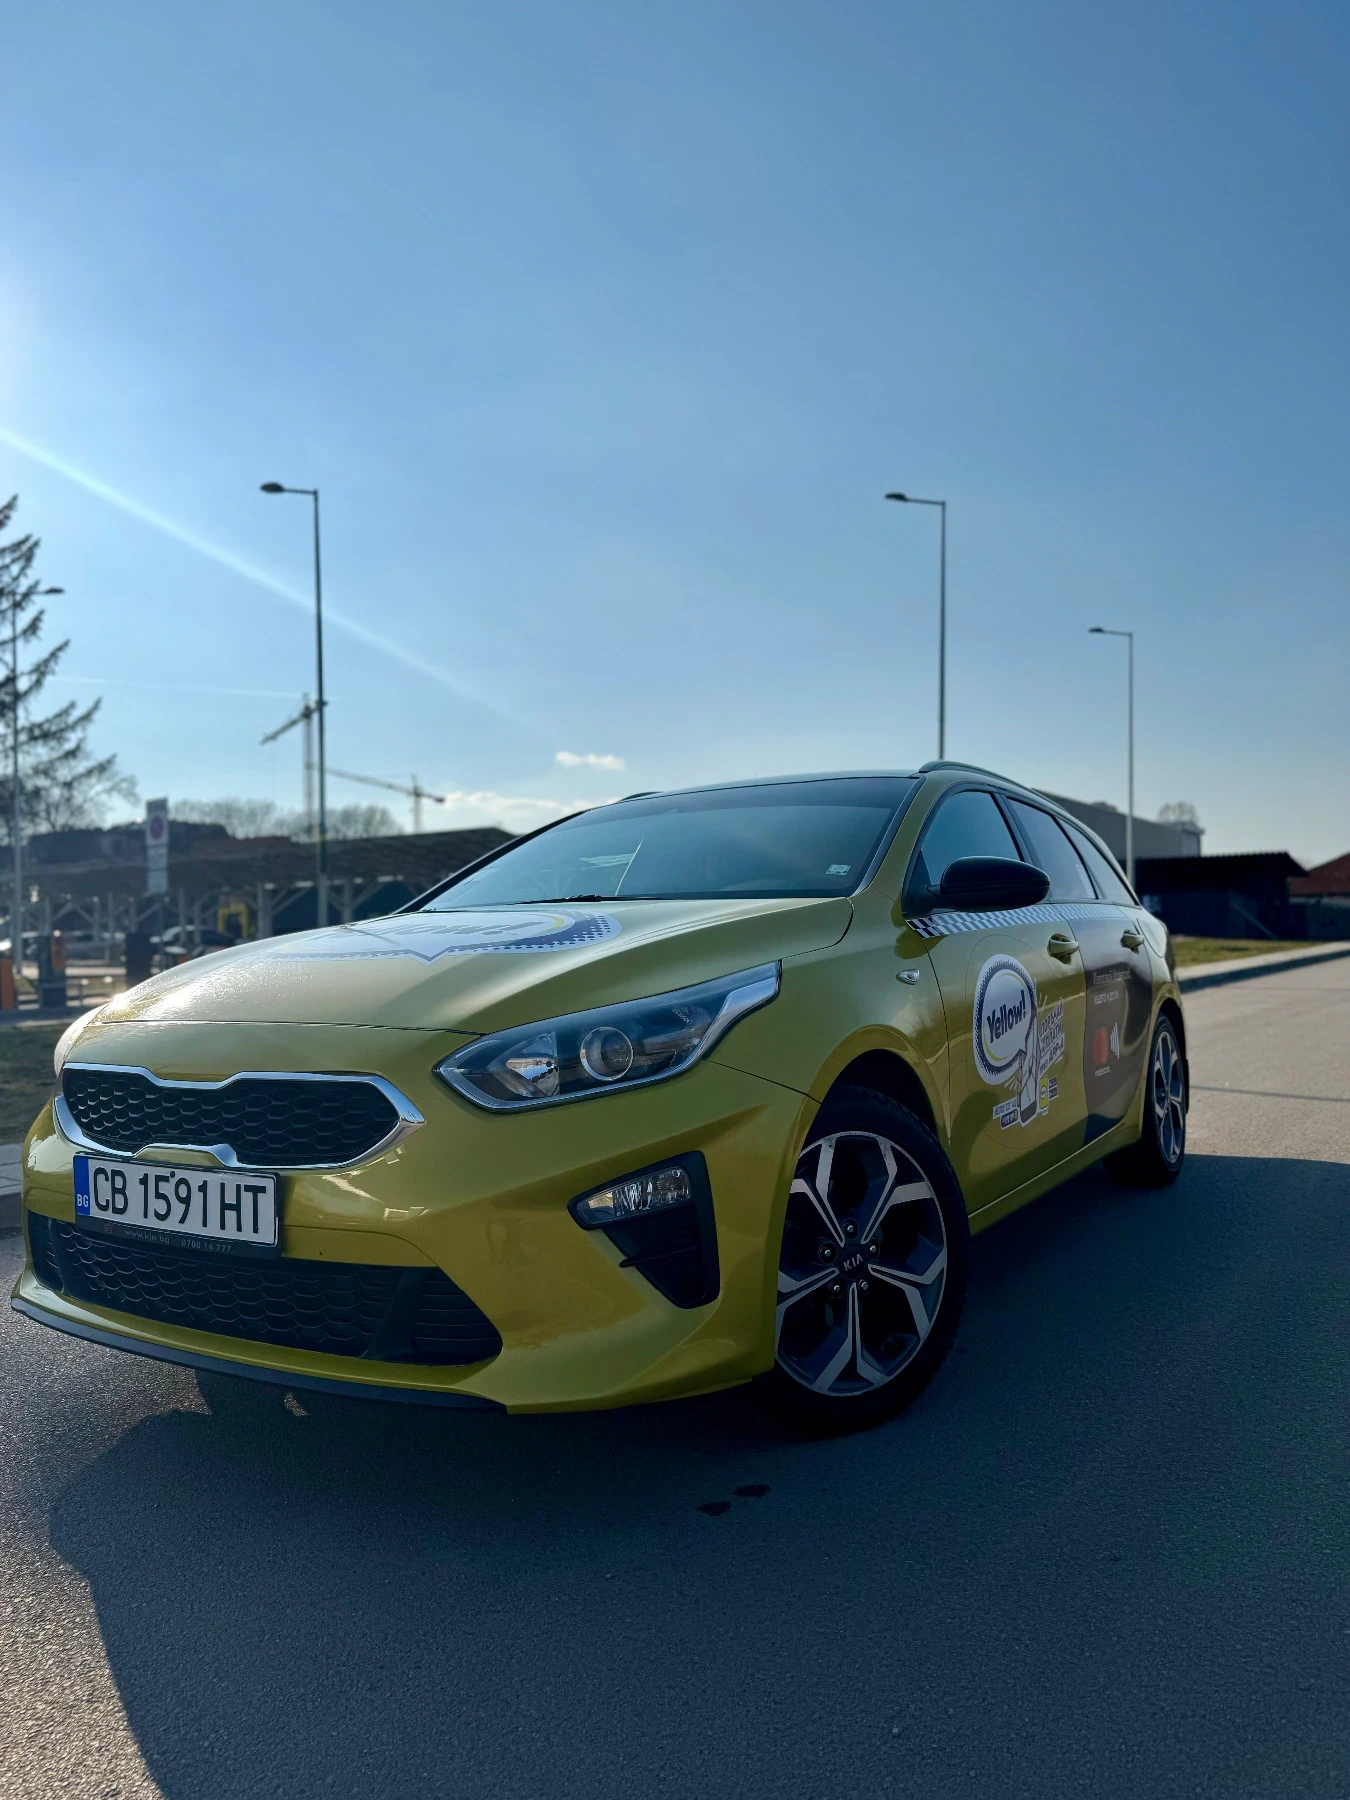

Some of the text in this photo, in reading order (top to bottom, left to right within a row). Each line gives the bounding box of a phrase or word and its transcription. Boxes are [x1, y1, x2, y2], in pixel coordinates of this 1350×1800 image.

[986, 989, 1027, 1044] Yellow!
[77, 1193, 89, 1208] BG
[93, 1166, 267, 1234] CB 1591 HT
[181, 1239, 201, 1249] 0700
[842, 1253, 864, 1272] KIA
